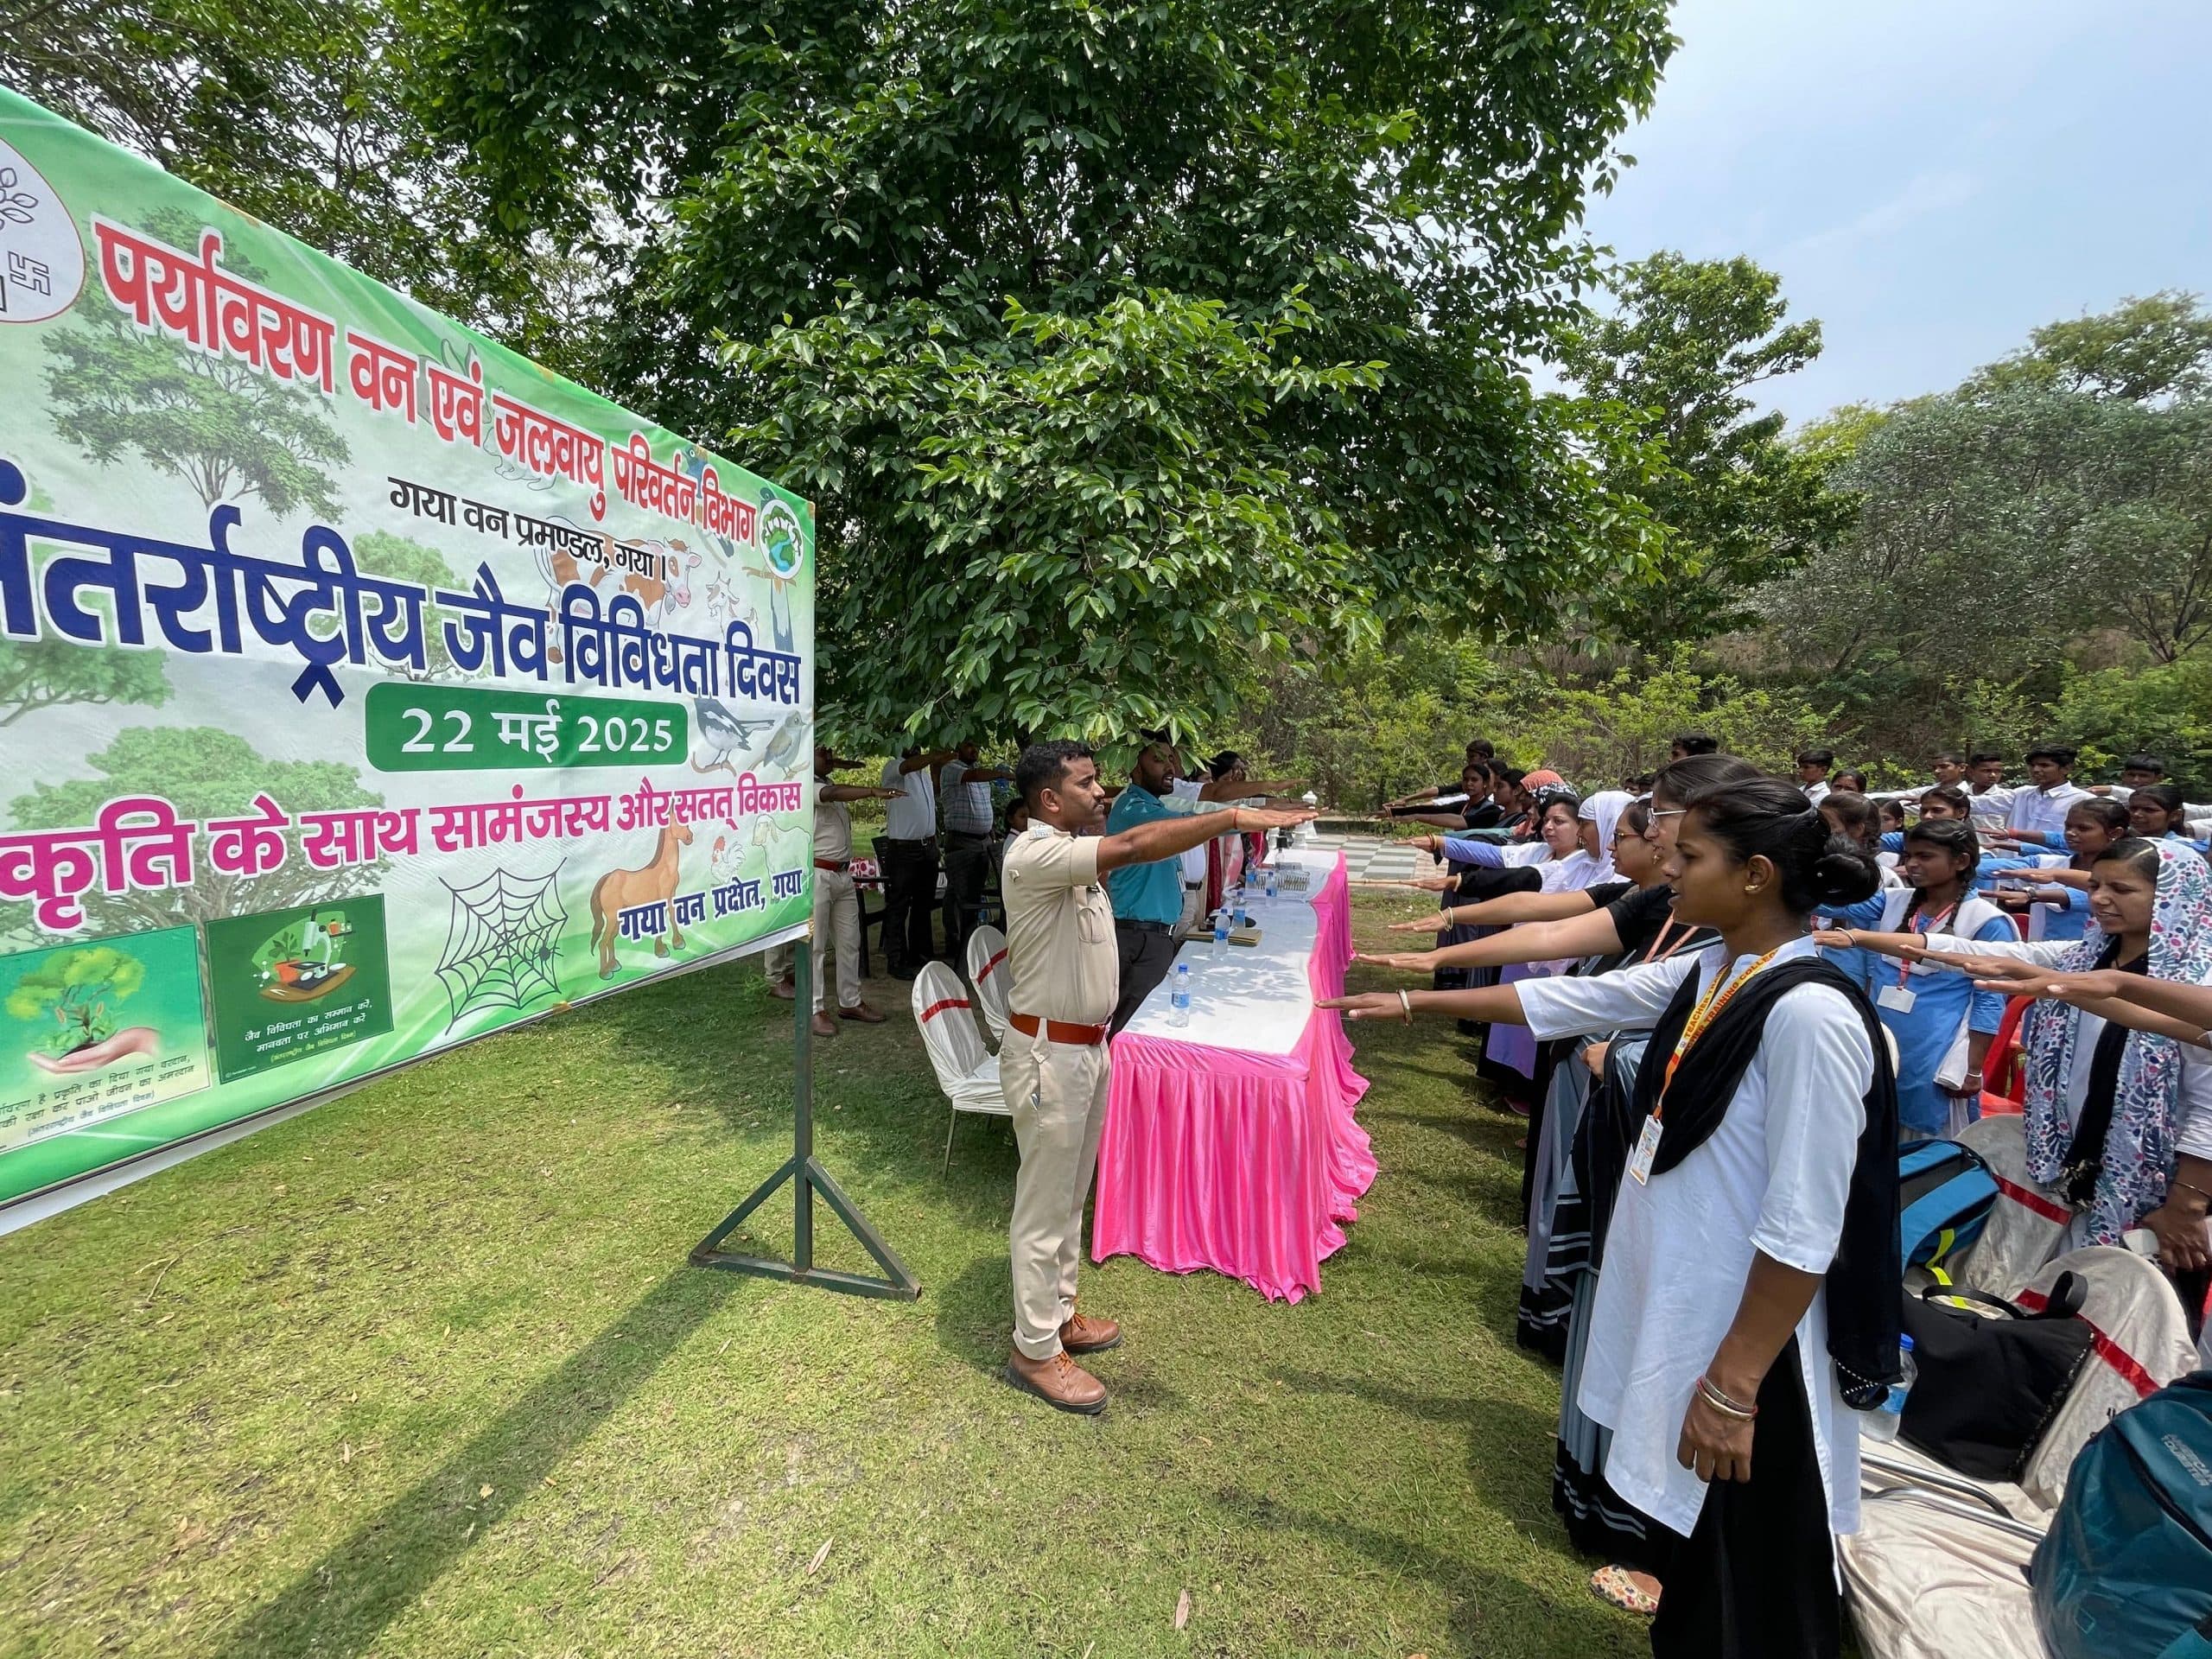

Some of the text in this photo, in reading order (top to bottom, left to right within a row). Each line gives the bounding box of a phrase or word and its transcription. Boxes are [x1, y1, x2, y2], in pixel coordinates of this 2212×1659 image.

[95, 221, 757, 549] पर्यावरण वन एवं जलवायु परिवर्तन विभाग
[387, 476, 458, 526] गया
[461, 499, 509, 539] वन
[0, 458, 802, 709] ंतर्राष्ट्रीय जैव विविधता दिवस
[401, 704, 673, 764] 22 मई 2025
[209, 795, 289, 874] के
[302, 808, 420, 868] साथ
[429, 785, 612, 853] सामंजस्य
[616, 777, 672, 830] और
[674, 787, 738, 830] सतत्
[737, 772, 802, 816] विकास
[619, 902, 667, 940] गया
[674, 893, 706, 926] वन
[772, 870, 803, 899] गया
[245, 1030, 261, 1041] जैव
[267, 1020, 302, 1036] विविधता
[307, 1015, 319, 1024] का
[324, 1006, 353, 1020] सम्मान
[1685, 996, 1710, 1039] TEACHER
[1704, 982, 1739, 1025] TRAINING
[256, 1037, 292, 1052] मानवता
[296, 1031, 309, 1040] पर
[315, 1020, 348, 1036] अभिमान
[52, 1101, 69, 1113] कर
[75, 1090, 99, 1105] पाओ
[106, 1082, 132, 1096] जीवन
[139, 1077, 151, 1087] का
[54, 1084, 82, 1101] प्रकृति
[88, 1079, 102, 1089] का
[109, 1071, 130, 1084] दिया
